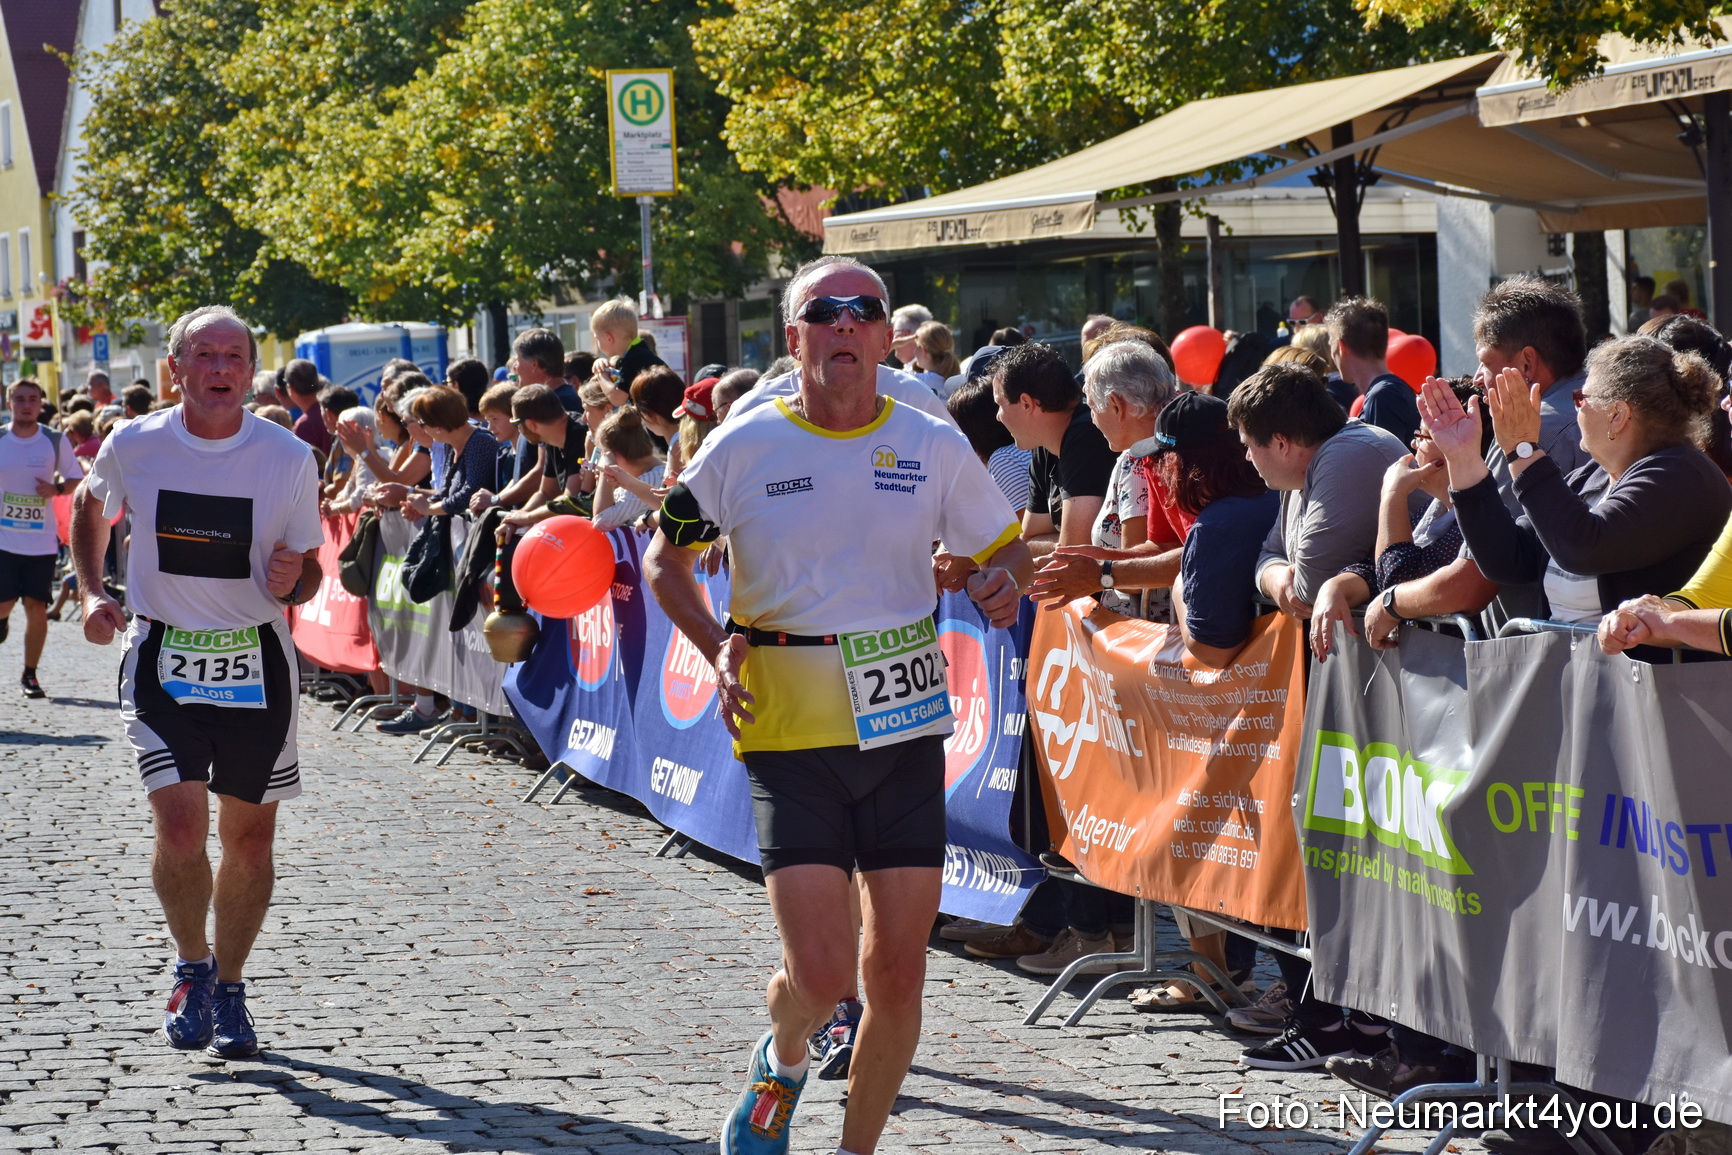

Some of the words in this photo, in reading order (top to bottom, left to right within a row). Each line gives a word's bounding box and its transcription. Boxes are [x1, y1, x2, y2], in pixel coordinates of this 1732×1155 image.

[630, 89, 652, 116] H
[623, 131, 662, 140] Marktplatz
[875, 451, 896, 468] 20
[767, 478, 811, 494] BOCK
[874, 470, 928, 482] Neumarkter
[874, 481, 916, 495] Stadtlauf
[6, 505, 41, 520] 2230
[173, 526, 231, 539] woodka
[611, 582, 634, 602] STORE
[170, 628, 252, 650] BOCK
[850, 619, 931, 662] BOCK
[170, 653, 250, 682] 2135
[863, 652, 940, 706] 2302
[1147, 660, 1191, 682] Neumarkts
[190, 686, 235, 700] ALOIS
[1159, 685, 1171, 703] die
[1170, 688, 1223, 711] Konzeption
[1222, 687, 1242, 704] und
[869, 697, 945, 732] WOLFGANG
[1168, 708, 1191, 727] Ihrer
[1190, 711, 1227, 734] Projekte
[568, 718, 594, 750] GET
[651, 757, 675, 795] GET
[1193, 789, 1210, 808] Sie
[1213, 789, 1236, 809] sich
[1236, 791, 1249, 811] bei
[1249, 798, 1265, 814] uns
[1071, 804, 1137, 855] Agentur
[1173, 815, 1198, 833] web:
[1200, 816, 1255, 841] codeclinic.de
[942, 844, 969, 887] GET
[1170, 840, 1190, 859] tel:
[1239, 849, 1259, 870] 897
[1301, 837, 1381, 879] inspired
[1383, 853, 1395, 892] by
